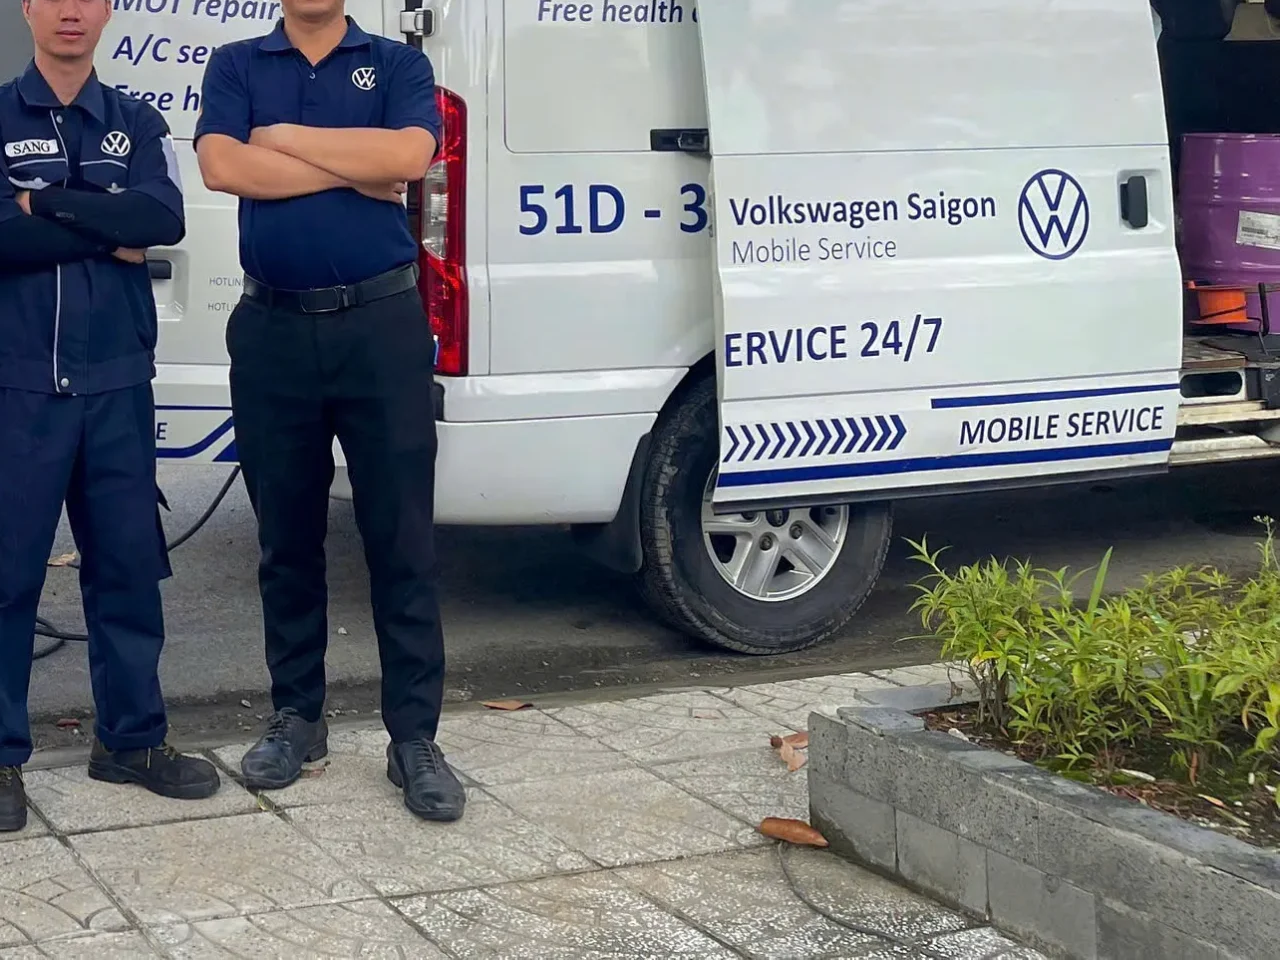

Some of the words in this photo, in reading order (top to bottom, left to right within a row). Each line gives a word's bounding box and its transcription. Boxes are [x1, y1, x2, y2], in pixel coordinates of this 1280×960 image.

[112, 34, 172, 66] A/C
[13, 141, 51, 155] SANG
[518, 183, 627, 236] 51D
[679, 183, 708, 234] 3
[729, 194, 899, 228] Volkswagen
[906, 191, 996, 226] Saigon
[732, 237, 811, 265] Mobile
[817, 236, 898, 262] Service
[723, 324, 848, 368] ERVICE
[859, 314, 943, 362] 24/7
[959, 412, 1059, 446] MOBILE
[1065, 406, 1165, 438] SERVICE
